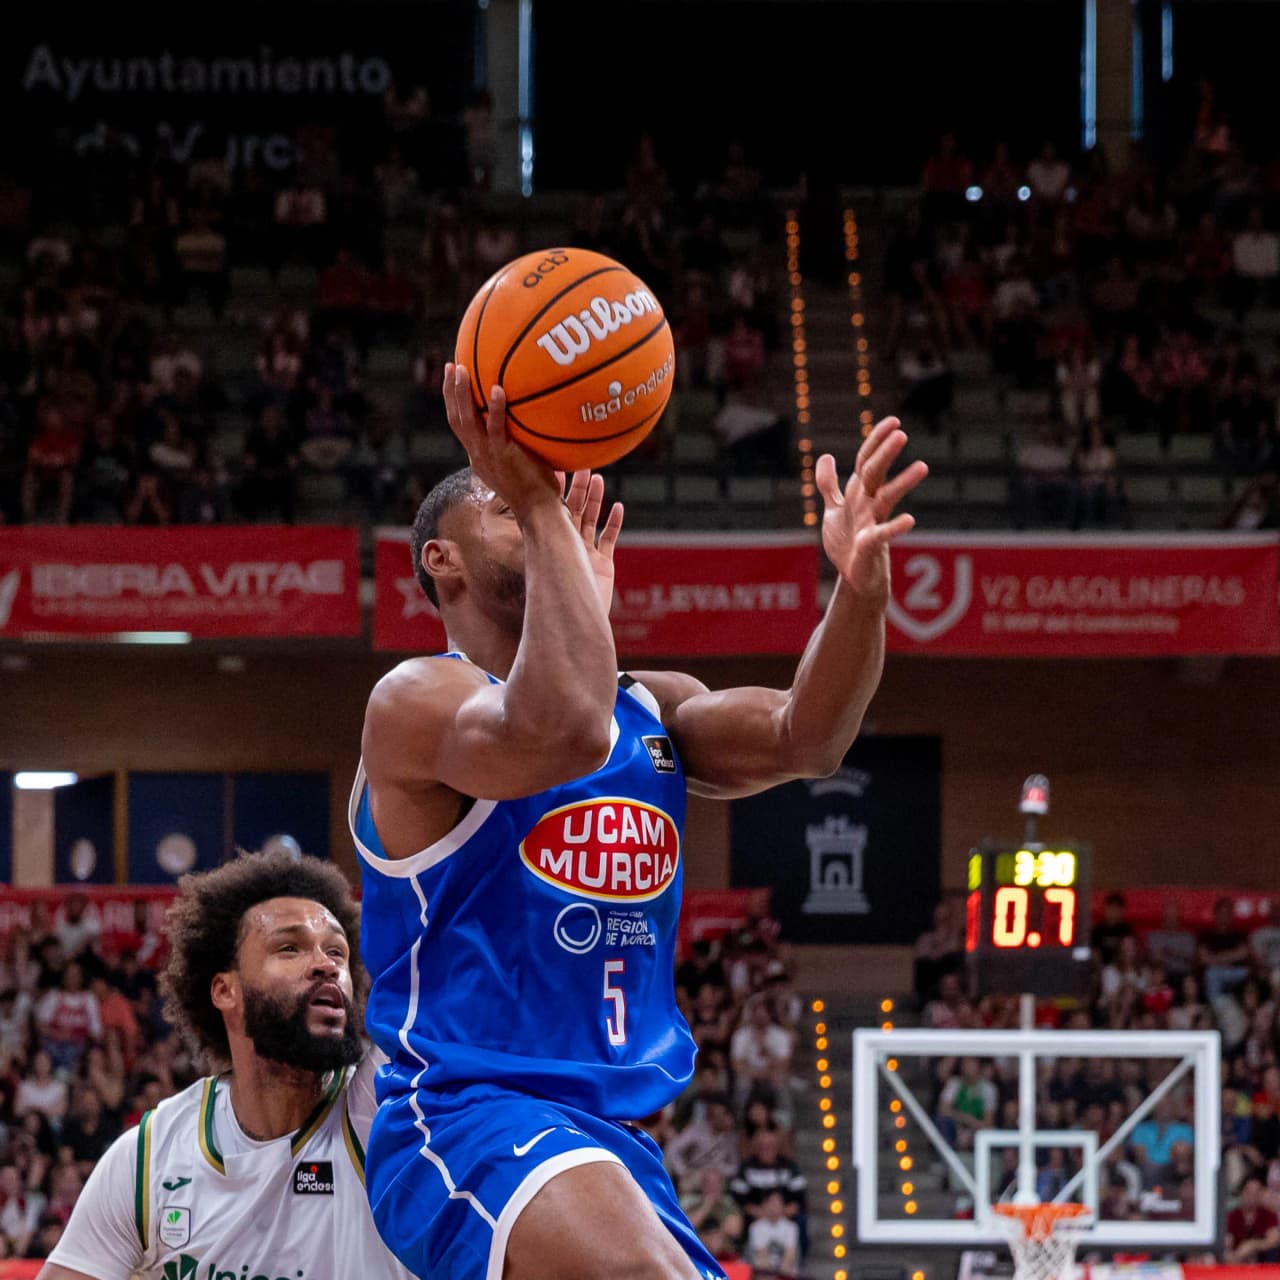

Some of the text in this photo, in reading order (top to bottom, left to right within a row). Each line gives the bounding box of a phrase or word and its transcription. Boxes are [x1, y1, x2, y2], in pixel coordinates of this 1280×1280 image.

[21, 41, 392, 103] Ayuntamiento
[537, 289, 659, 366] Wilson
[31, 560, 345, 596] IBERIA VITAE
[981, 576, 1018, 607] V2
[563, 805, 666, 848] UCAM
[539, 847, 674, 891] MURCIA
[605, 932, 619, 946] DE
[992, 886, 1076, 949] 0.7
[603, 959, 626, 1047] 5
